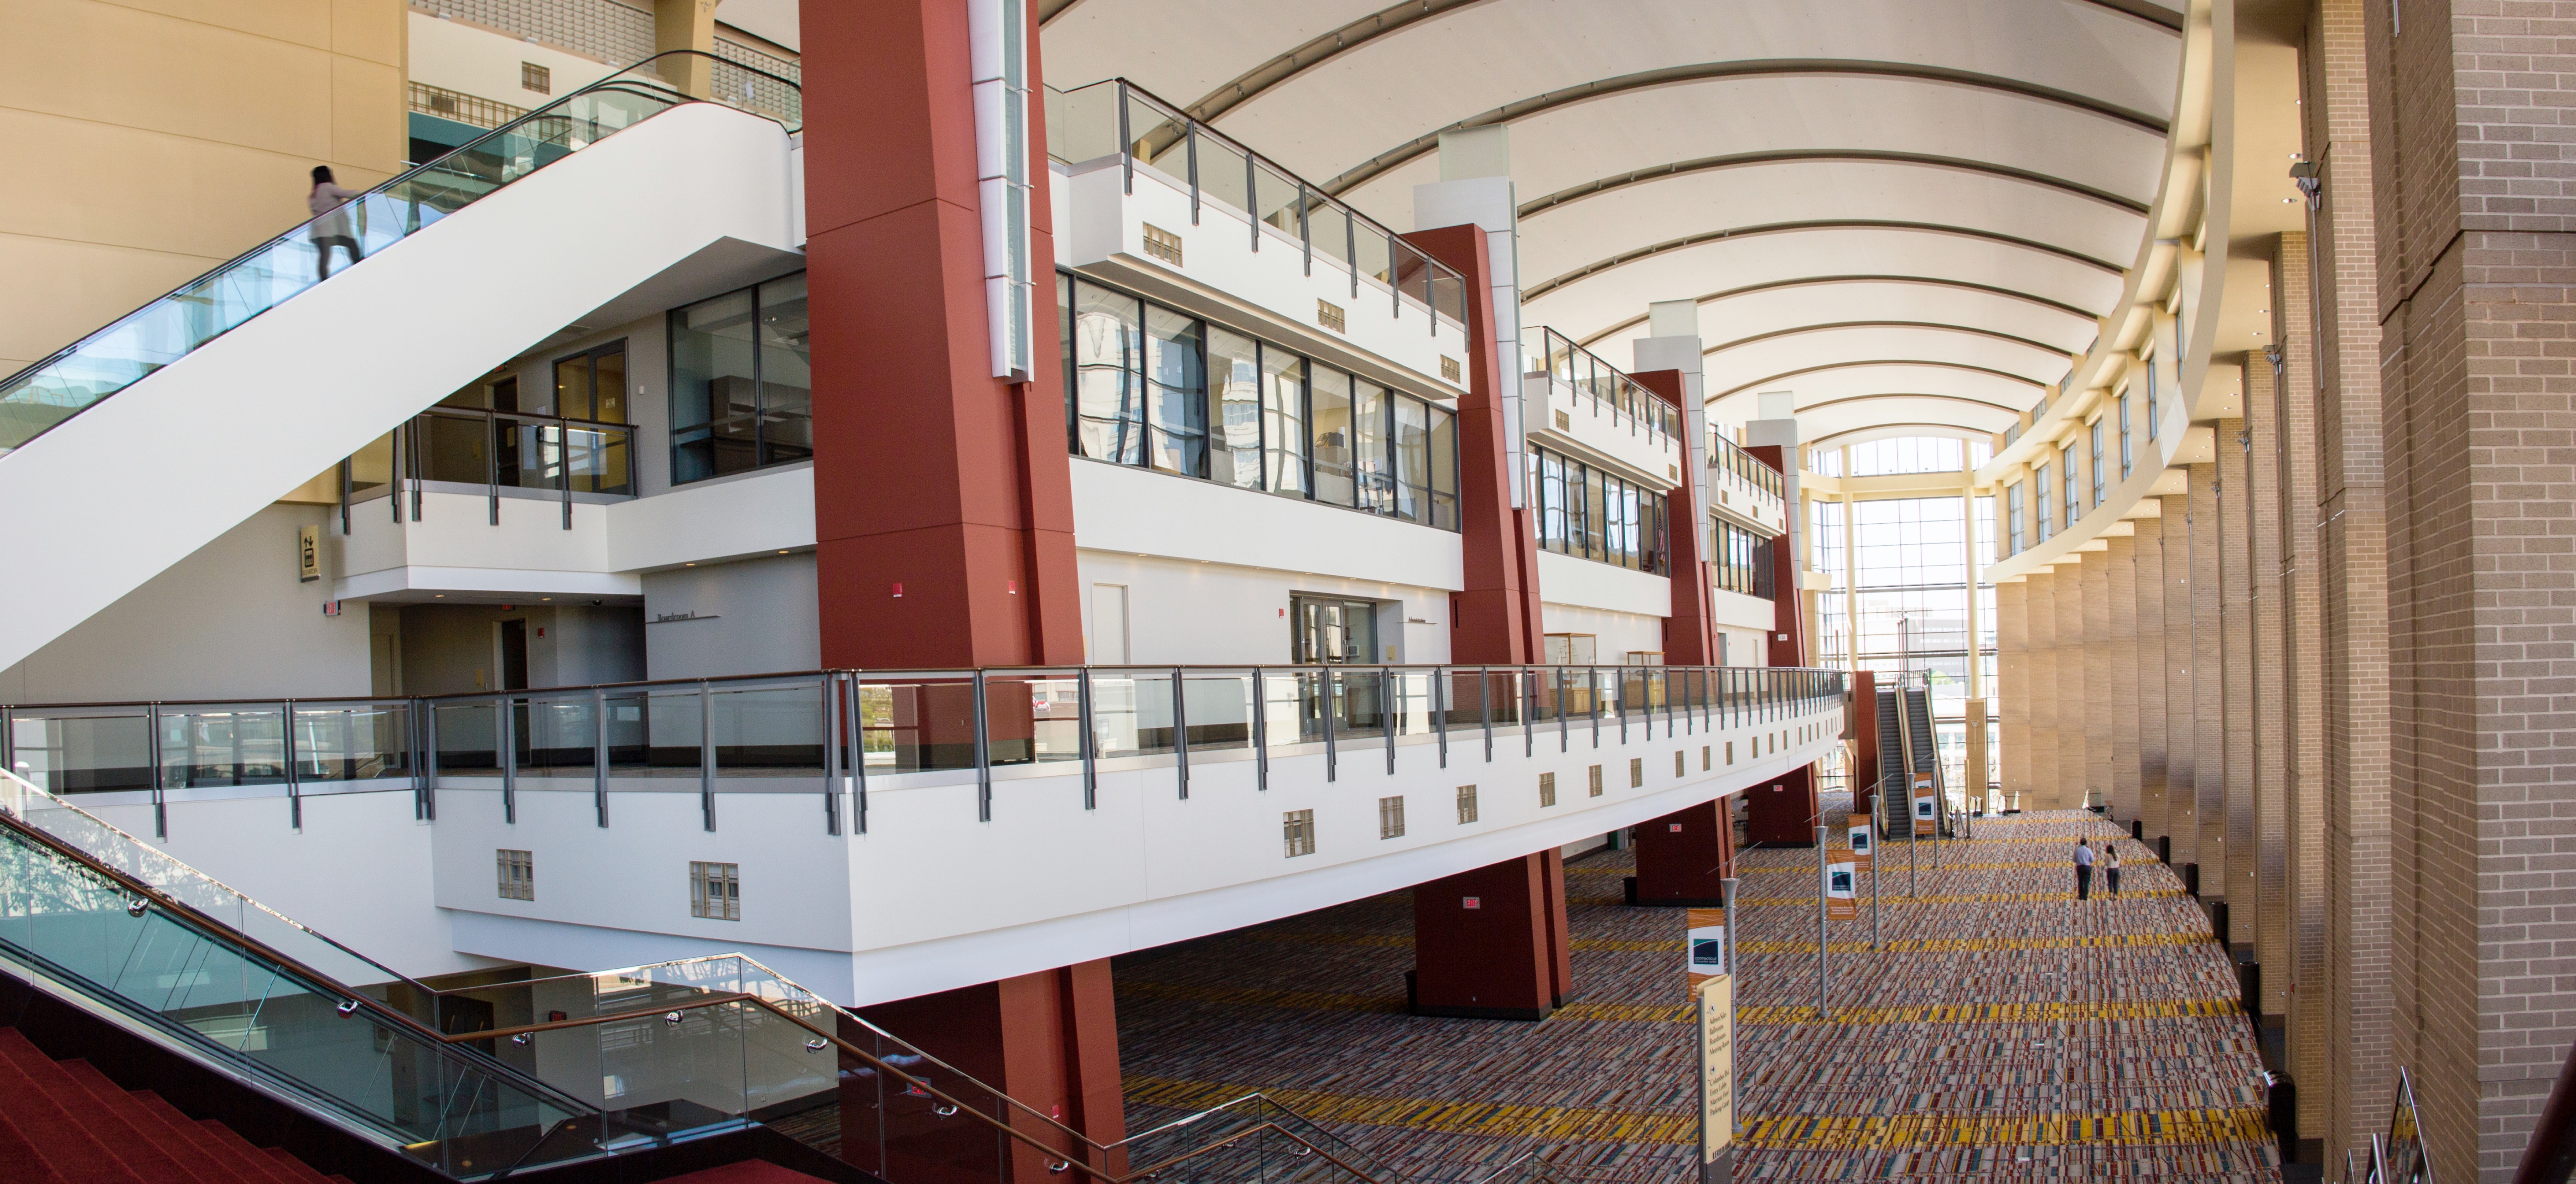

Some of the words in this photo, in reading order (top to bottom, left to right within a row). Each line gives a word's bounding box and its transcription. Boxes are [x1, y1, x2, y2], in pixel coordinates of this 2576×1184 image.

[328, 602, 336, 613] EXIT
[658, 612, 689, 622] Boardroom
[690, 610, 695, 618] A
